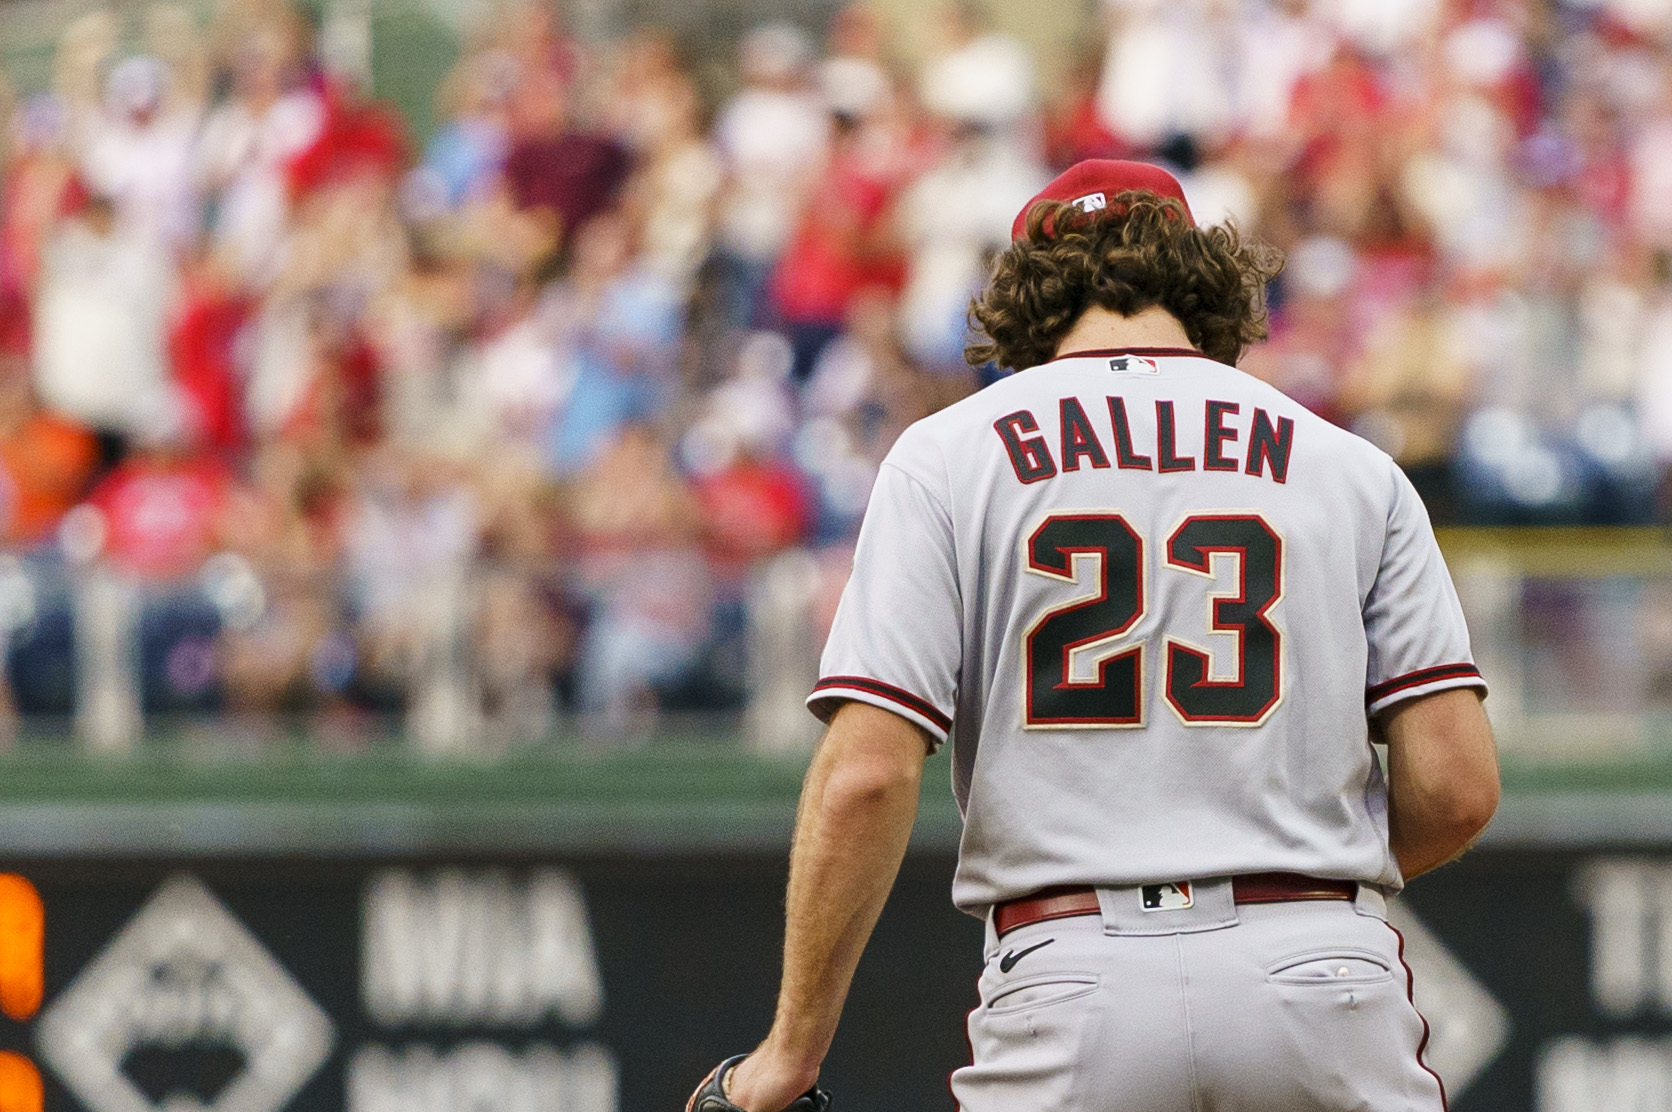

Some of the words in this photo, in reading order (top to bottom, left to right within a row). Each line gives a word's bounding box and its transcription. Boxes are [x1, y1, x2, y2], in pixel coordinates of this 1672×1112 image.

[993, 396, 1294, 484] GALLEN
[1022, 508, 1286, 729] 23
[364, 868, 600, 1025] MIA
